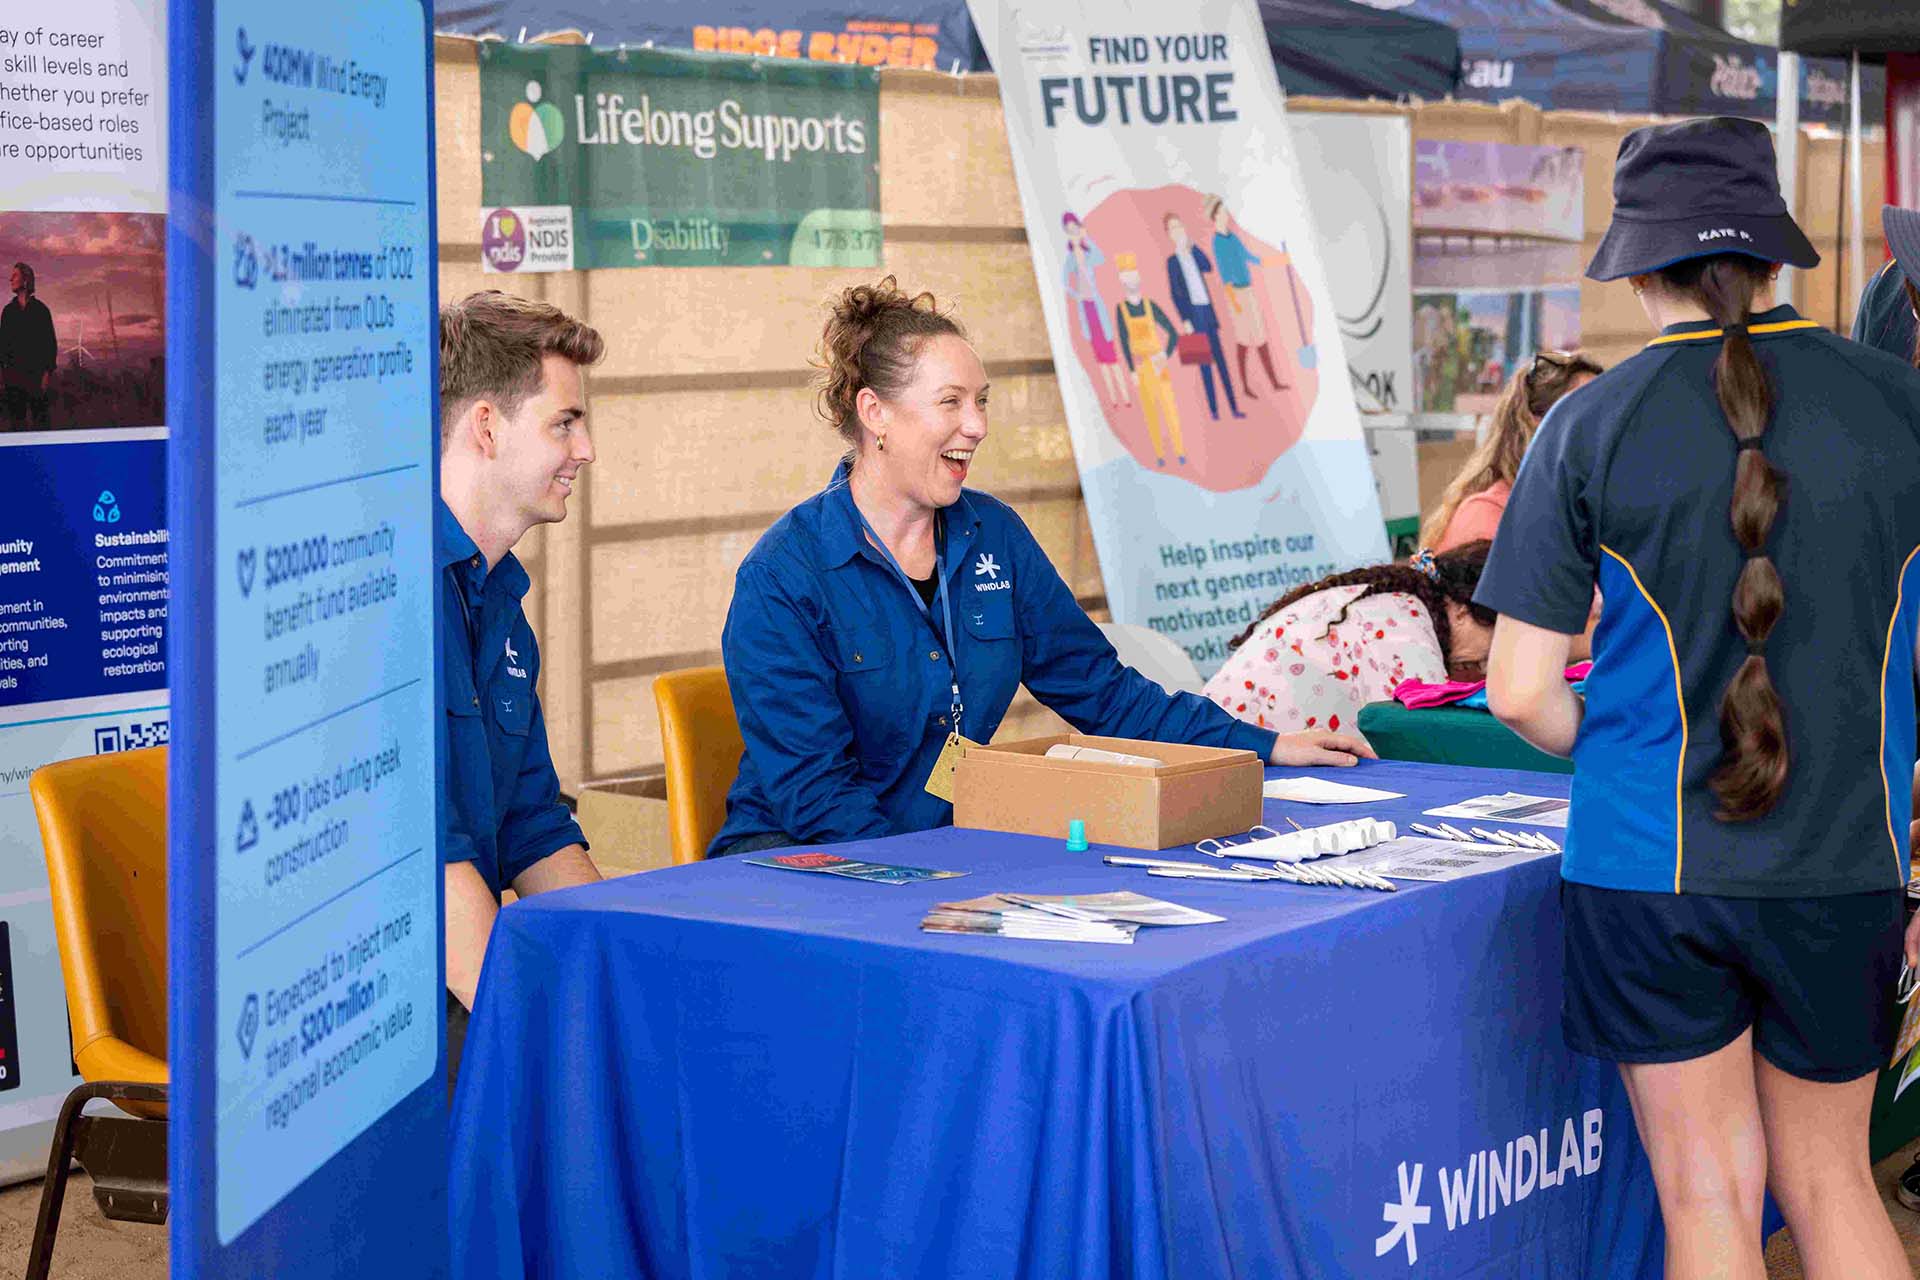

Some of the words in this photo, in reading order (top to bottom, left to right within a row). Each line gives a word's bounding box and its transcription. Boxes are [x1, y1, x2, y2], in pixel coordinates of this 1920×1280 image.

[25, 28, 43, 45] of
[50, 33, 104, 48] career
[1088, 36, 1150, 65] FIND
[1156, 34, 1228, 63] YOUR
[4, 54, 37, 73] skill
[43, 57, 92, 76] levels
[98, 60, 129, 77] and
[0, 82, 58, 102] hether
[64, 89, 95, 106] you
[101, 88, 149, 108] prefer
[350, 61, 388, 108] Energy
[1040, 72, 1239, 128] FUTURE
[100, 115, 139, 133] roles
[263, 99, 310, 147] Project
[575, 93, 717, 160] Lifelong
[720, 100, 867, 162] Supports
[0, 144, 19, 158] re
[25, 142, 143, 162] opportunities
[490, 242, 521, 262] ndis
[529, 230, 568, 248] NDIS
[630, 218, 730, 256] Disability
[1697, 227, 1737, 242] KATE
[292, 242, 332, 280] million
[375, 246, 387, 280] of
[389, 246, 413, 280] CO2
[264, 299, 331, 337] eliminated
[334, 296, 362, 331] from
[264, 359, 309, 395] energy
[313, 348, 376, 392] generation
[378, 341, 413, 384] profile
[264, 410, 297, 444] each
[301, 408, 327, 444] year
[97, 552, 168, 569] Commitment
[332, 521, 396, 568] community
[1160, 544, 1207, 570] Help
[1210, 534, 1281, 563] inspire
[1286, 534, 1315, 552] our
[98, 575, 110, 586] to
[113, 570, 170, 586] minimising
[974, 580, 1011, 592] WINDLAB
[1155, 575, 1200, 601] next
[1205, 563, 1313, 600] generation
[34, 599, 44, 613] in
[100, 607, 145, 624] impacts
[148, 605, 168, 619] and
[264, 591, 313, 641] benefit
[316, 584, 346, 621] fund
[350, 566, 397, 614] available
[1148, 600, 1251, 633] motivated
[101, 626, 163, 642] supporting
[102, 642, 158, 659] ecological
[27, 653, 48, 667] and
[103, 660, 165, 677] restoration
[264, 643, 320, 694] annually
[301, 777, 331, 824] jobs
[332, 759, 371, 800] during
[373, 738, 401, 787] peak
[264, 818, 349, 887] construction
[265, 952, 327, 1027] Expected
[331, 951, 345, 982] to
[348, 926, 381, 974] inject
[383, 911, 412, 949] more
[266, 1035, 298, 1078] than
[335, 979, 374, 1029] million
[377, 969, 388, 999] in
[266, 1059, 320, 1130] regional
[323, 1020, 381, 1087] economic
[383, 1001, 413, 1041] value
[1438, 1108, 1603, 1231] WINDLAB
